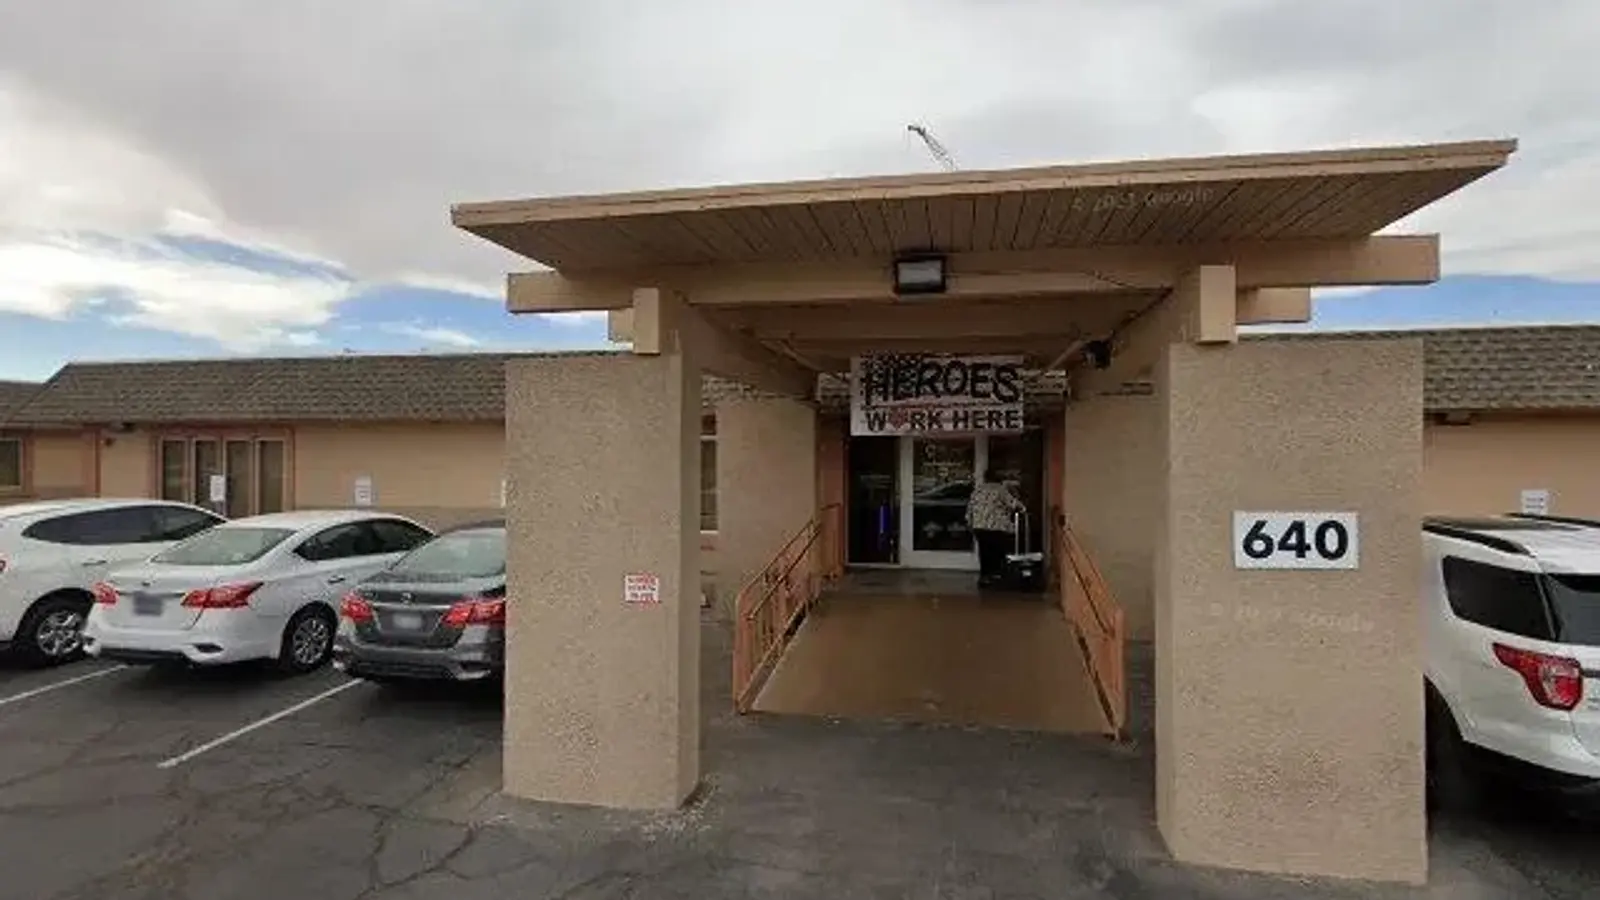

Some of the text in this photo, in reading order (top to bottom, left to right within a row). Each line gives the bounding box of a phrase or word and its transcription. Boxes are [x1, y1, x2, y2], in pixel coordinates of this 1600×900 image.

[865, 359, 1020, 404] HEROES
[952, 409, 1020, 430] HERE
[1243, 520, 1349, 560] 640
